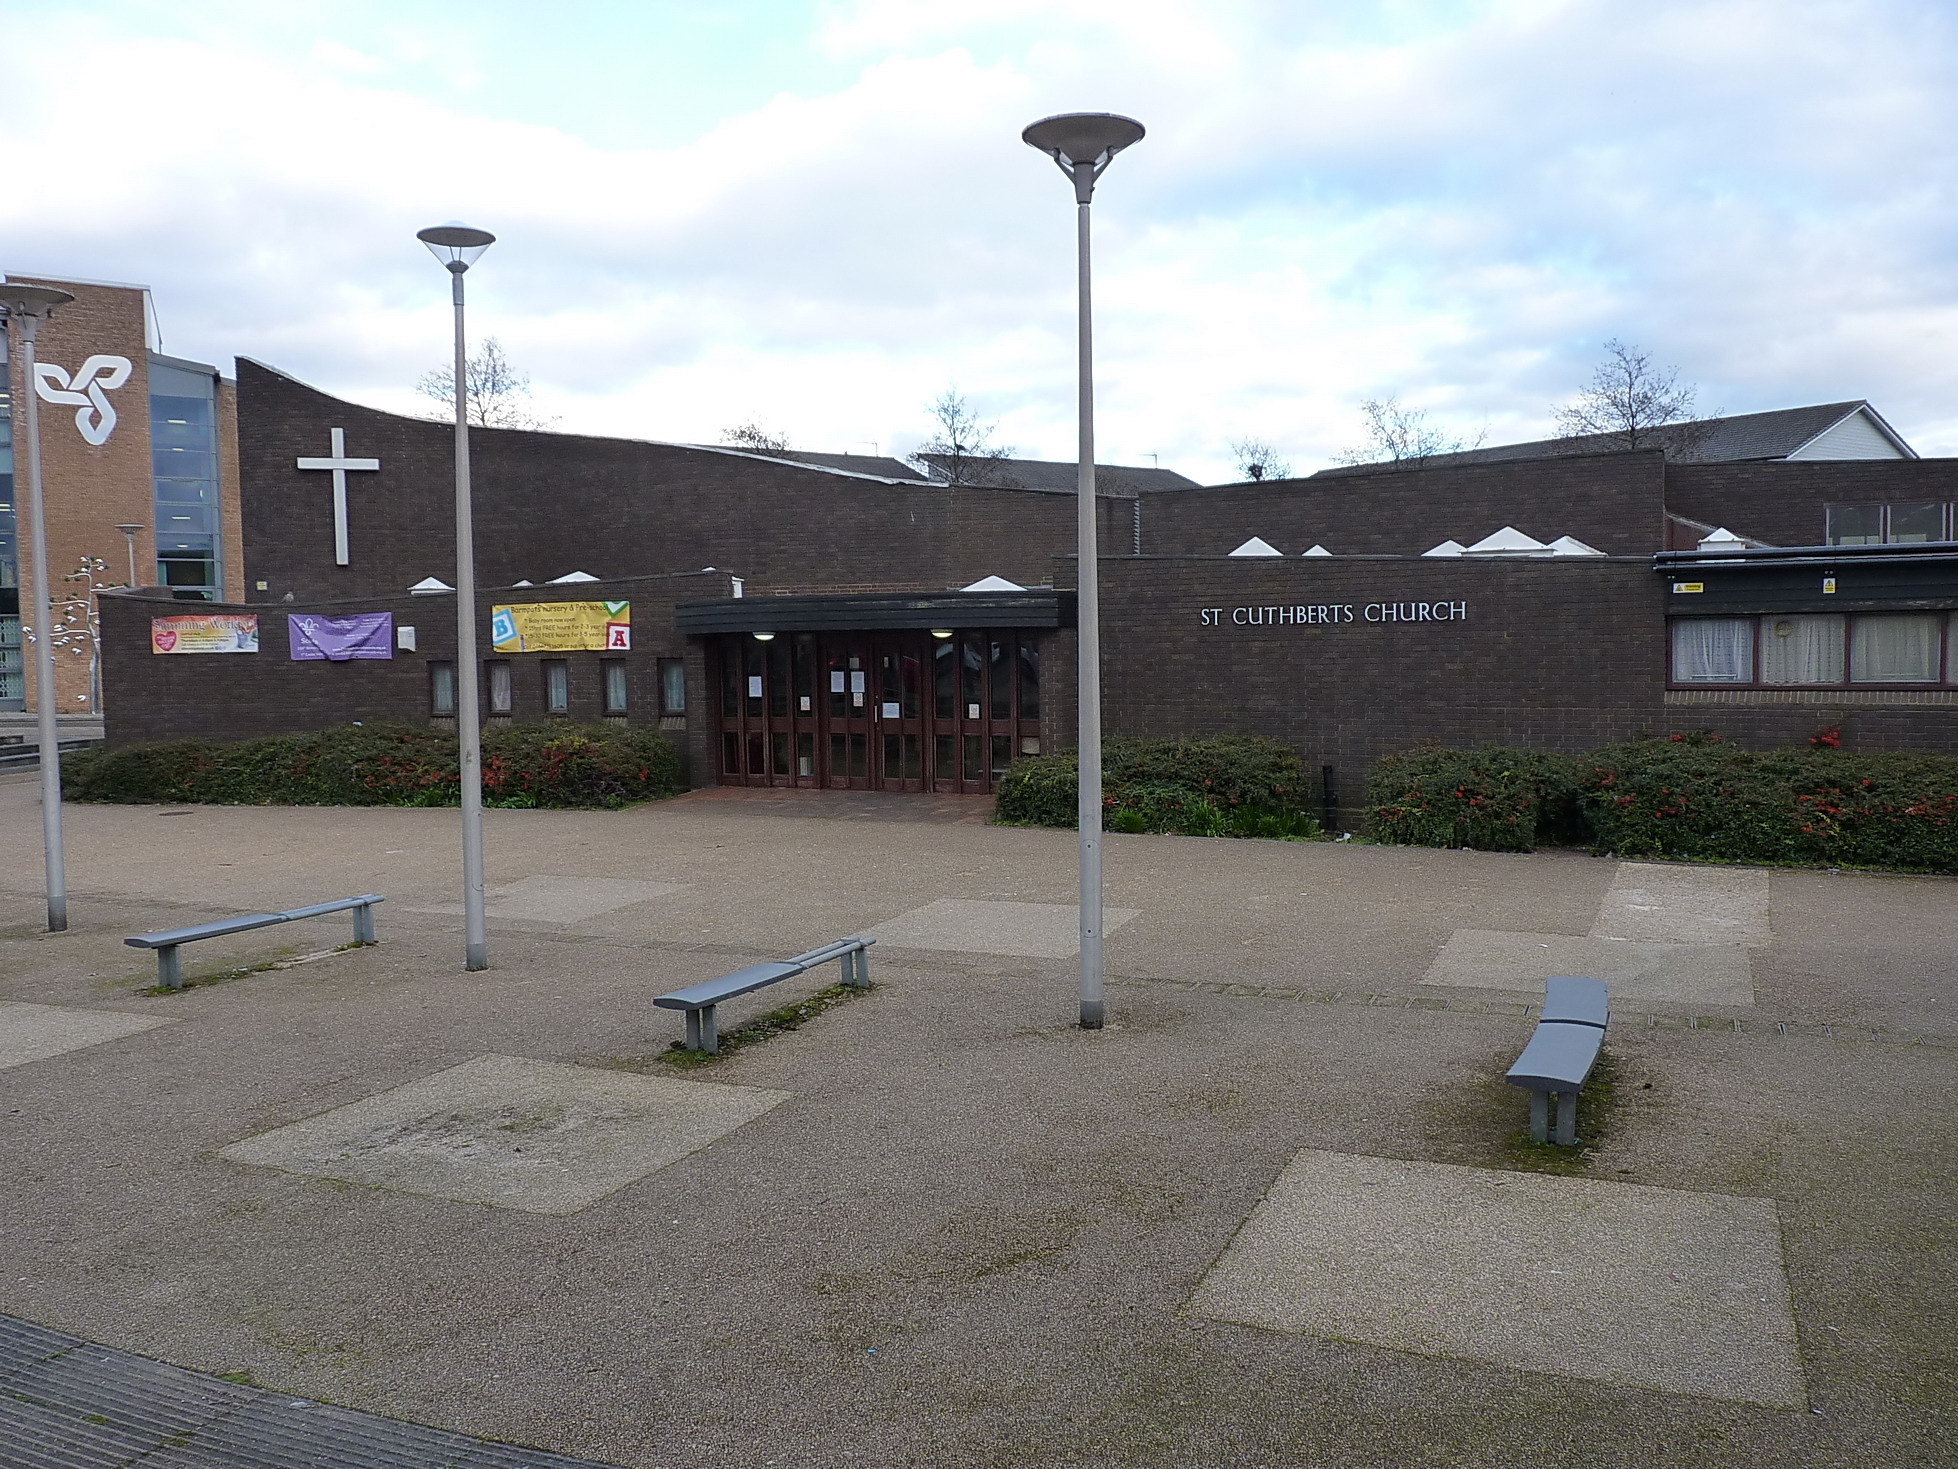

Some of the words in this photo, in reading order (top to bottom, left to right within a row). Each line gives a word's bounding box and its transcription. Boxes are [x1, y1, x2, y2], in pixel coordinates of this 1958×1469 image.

[1201, 608, 1223, 626] ST
[1232, 604, 1354, 625] CUTHBERTS
[1364, 601, 1467, 622] CHURCH
[494, 619, 508, 637] B
[611, 630, 627, 647] A
